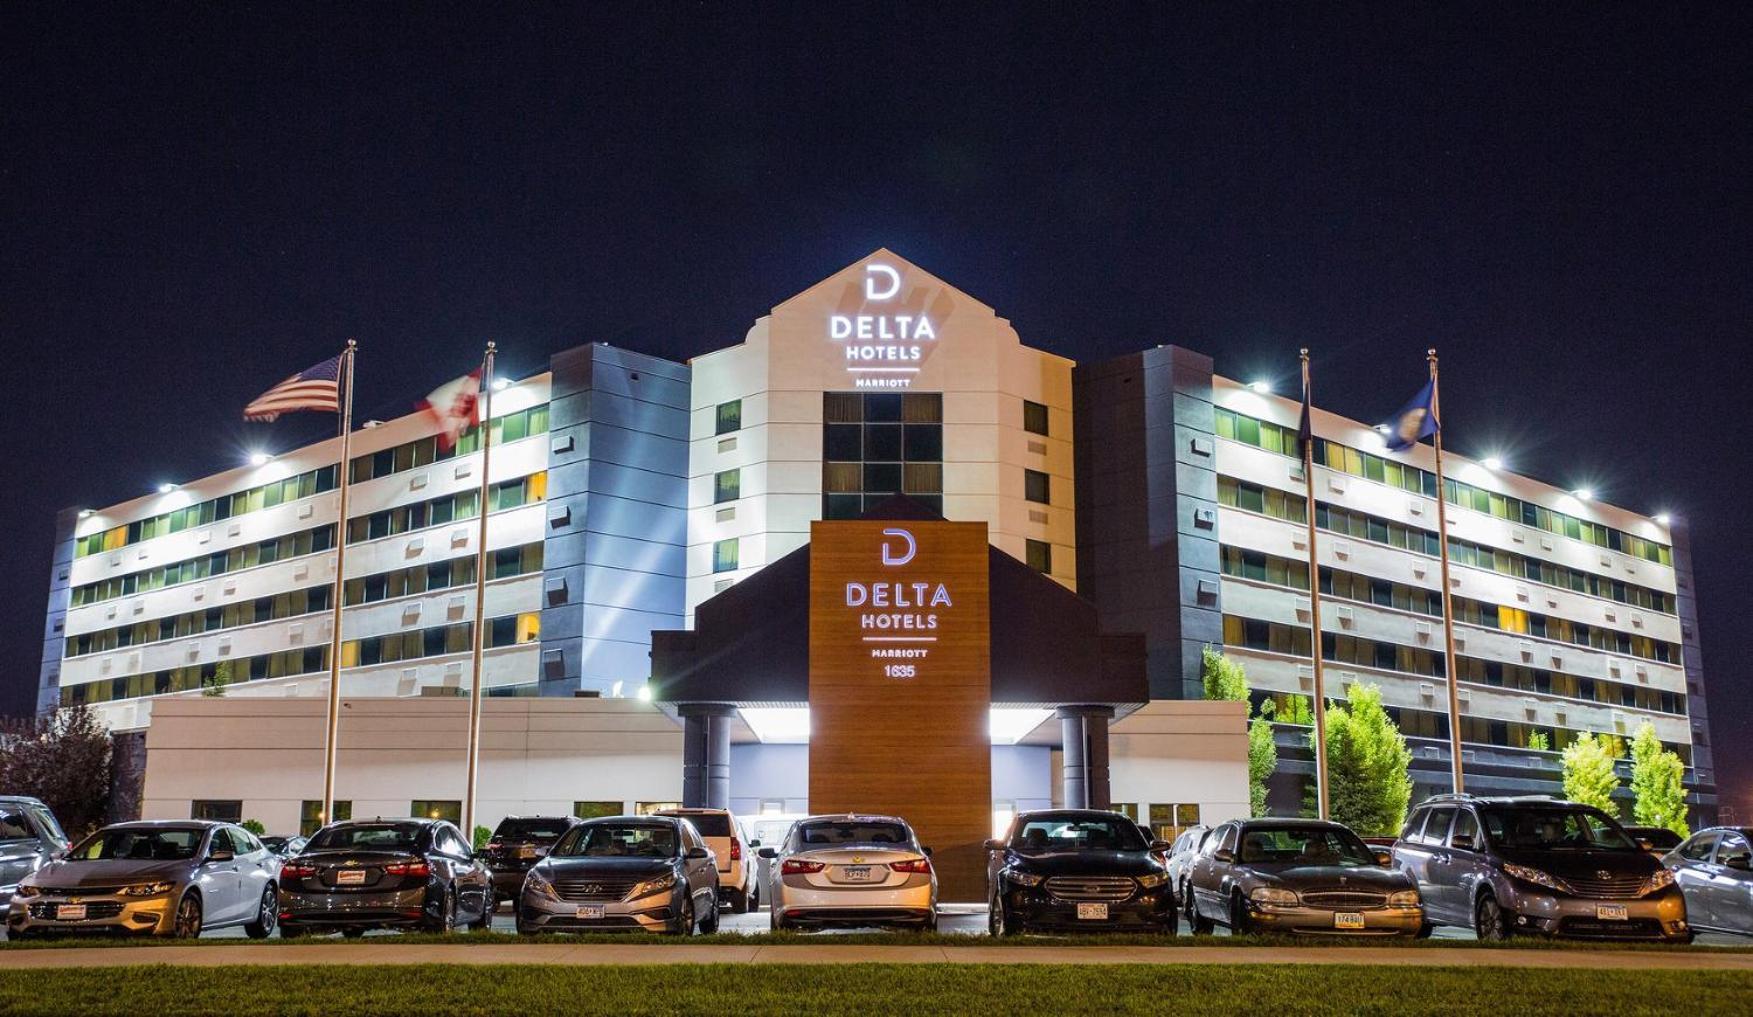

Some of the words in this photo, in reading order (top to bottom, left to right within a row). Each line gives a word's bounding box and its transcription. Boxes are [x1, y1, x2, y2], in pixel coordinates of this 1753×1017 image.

[830, 315, 936, 339] DELTA
[846, 346, 920, 360] HOTELS
[855, 379, 911, 388] MARRIOTT
[846, 583, 952, 606] DELTA
[861, 614, 938, 629] HOTELS
[871, 649, 928, 658] MARRIOTT
[884, 664, 916, 678] 1635
